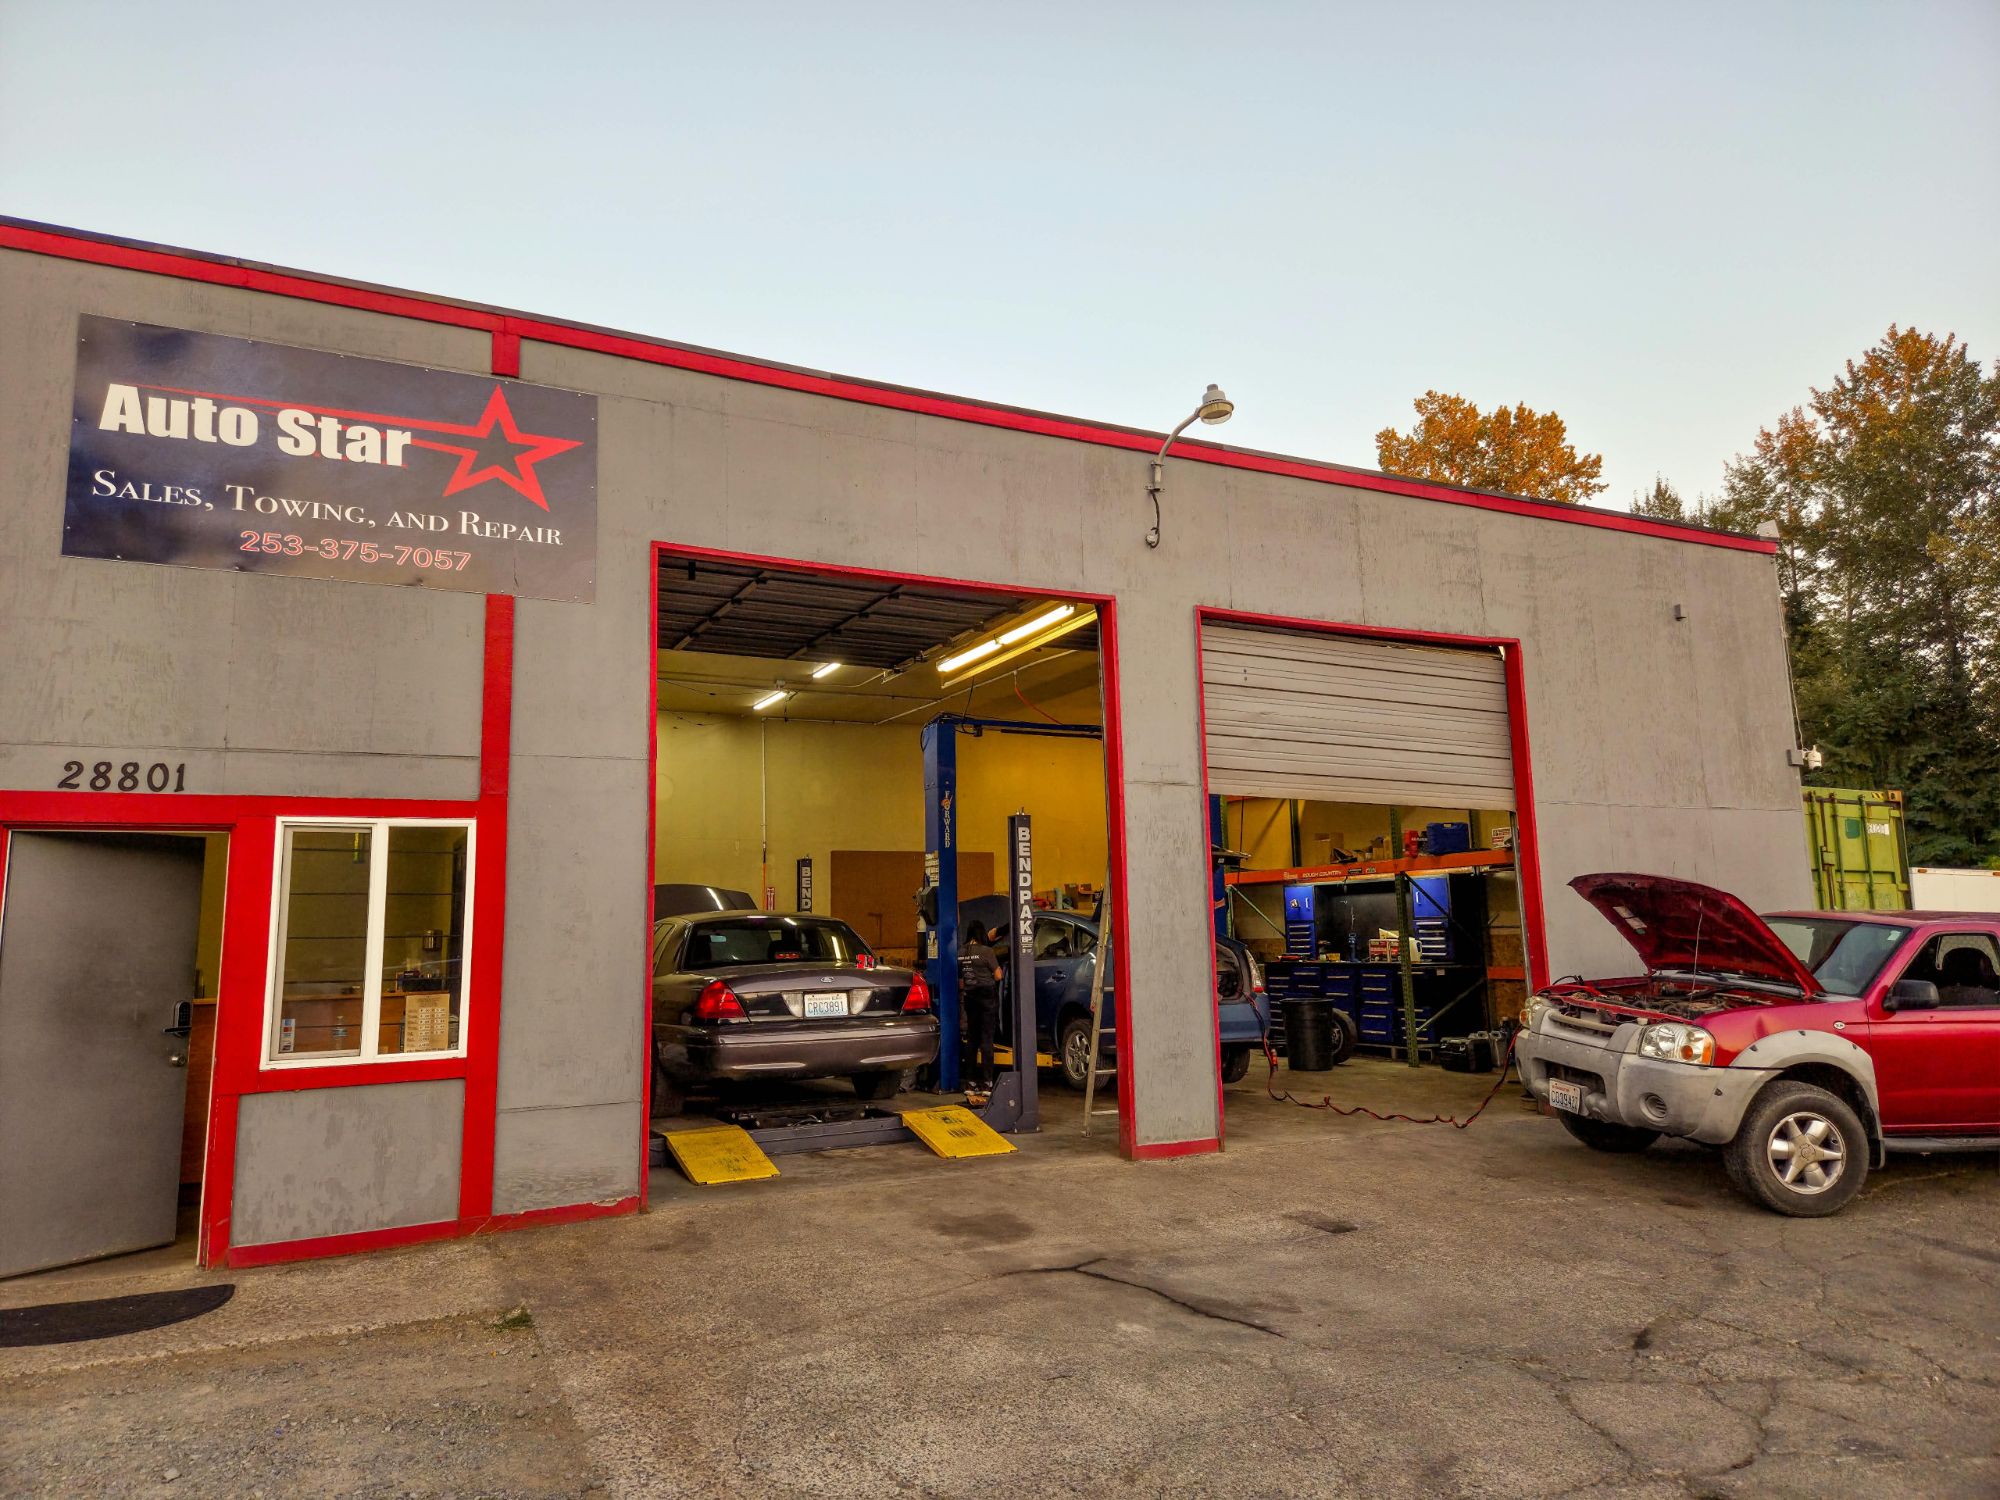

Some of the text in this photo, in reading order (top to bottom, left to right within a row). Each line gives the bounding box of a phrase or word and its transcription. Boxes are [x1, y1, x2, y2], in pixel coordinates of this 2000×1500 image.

[99, 383, 412, 467] Auto Star
[240, 530, 472, 571] 253-375-7057
[458, 510, 563, 546] REPAIR
[57, 760, 185, 792] 28801
[943, 790, 951, 848] FORWARD
[801, 866, 812, 911] BEND
[1018, 826, 1033, 935] BENDPAK
